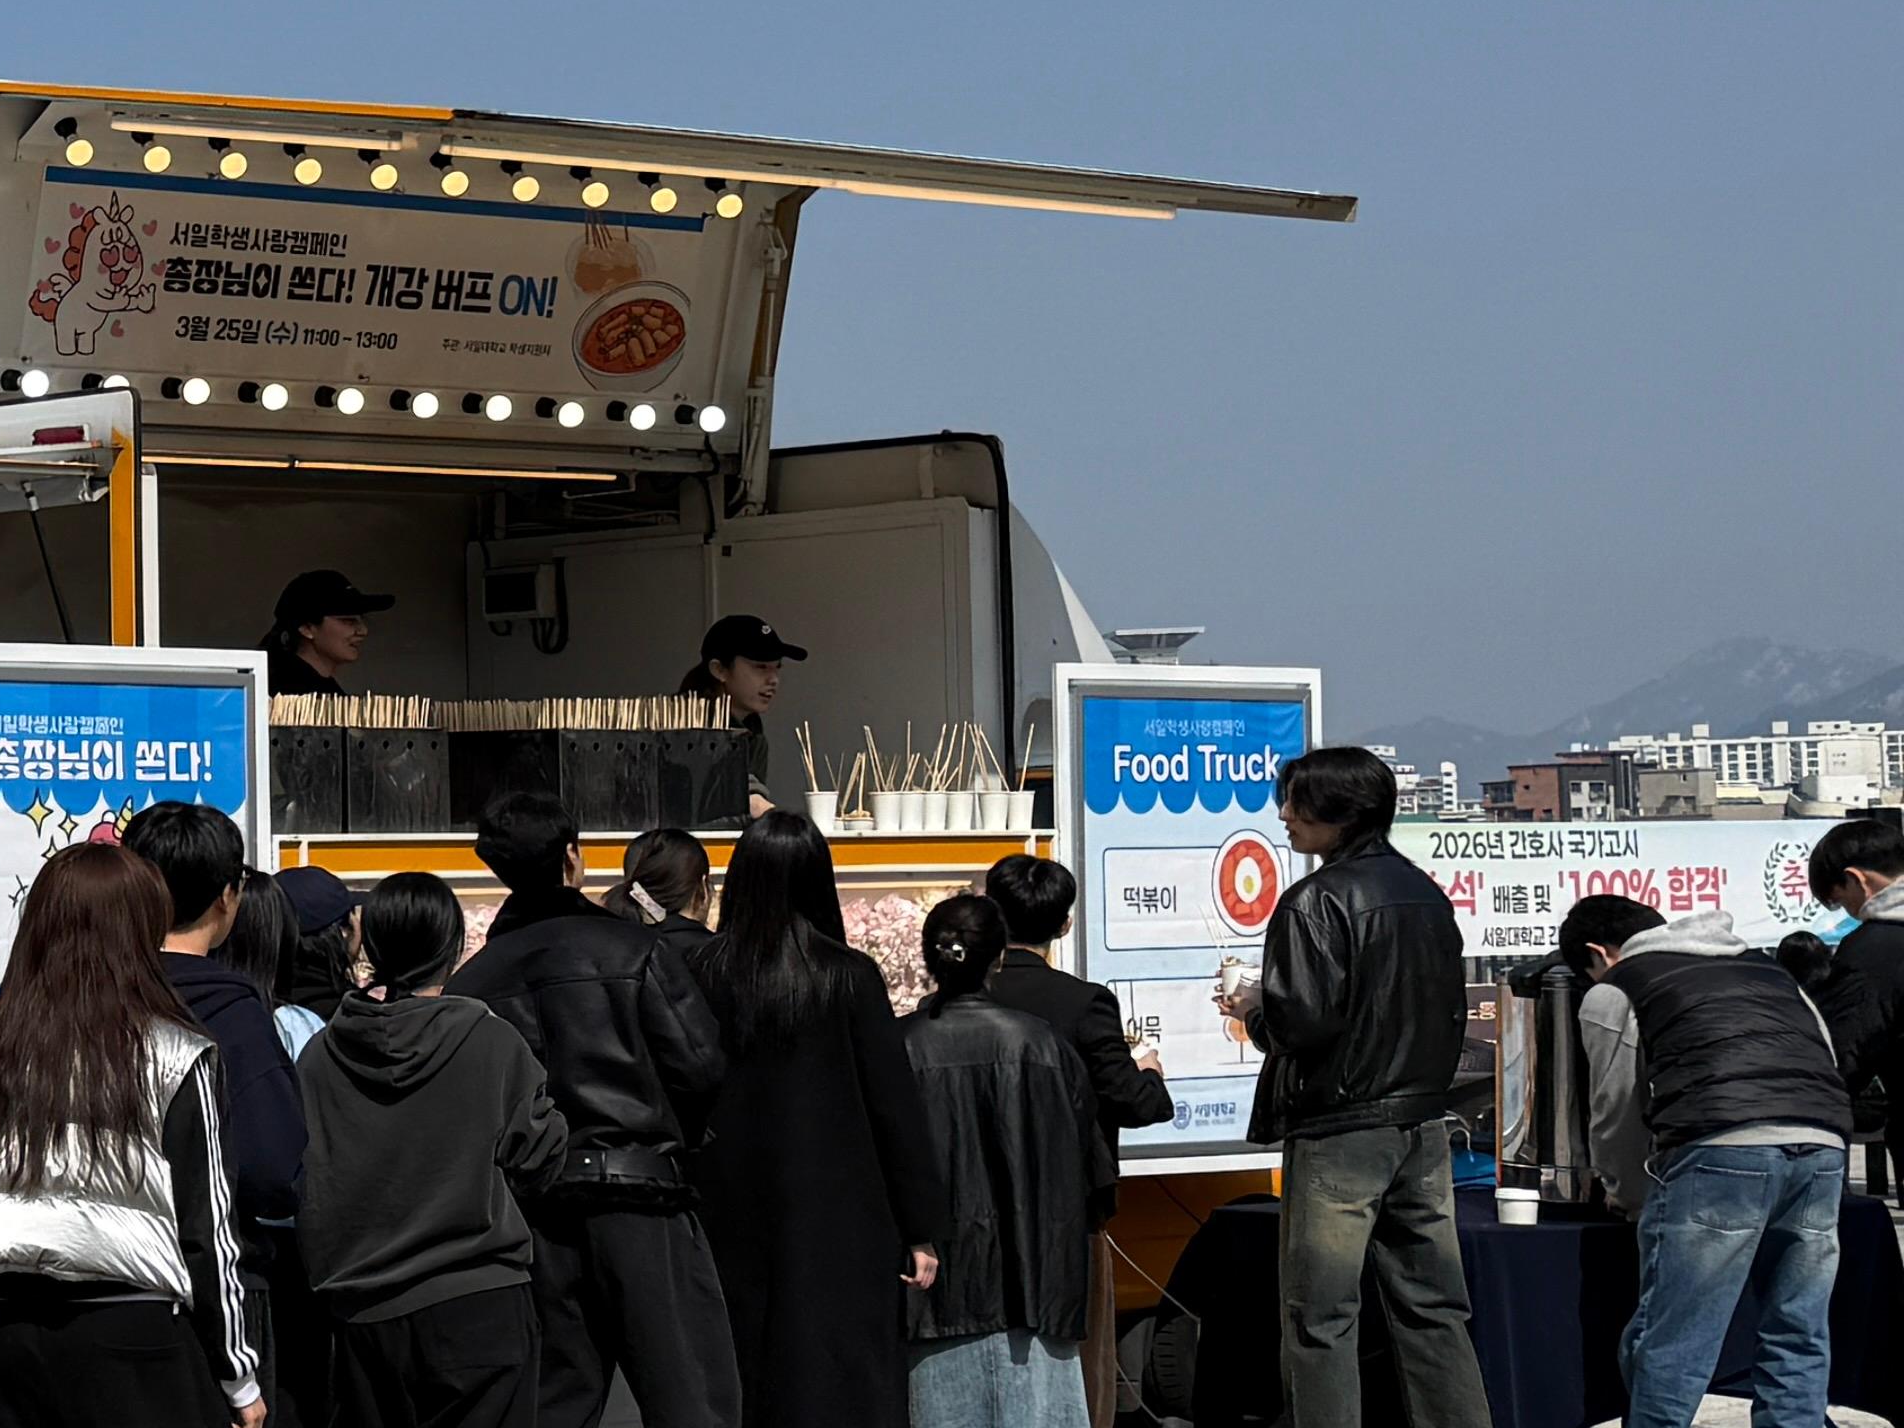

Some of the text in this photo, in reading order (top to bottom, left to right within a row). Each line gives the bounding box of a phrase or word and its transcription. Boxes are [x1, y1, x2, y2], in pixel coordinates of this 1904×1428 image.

[169, 221, 348, 257] 서일학생사랑캠페인
[163, 256, 558, 318] 총장님이 쏜다! 개강 버프 ON!
[175, 315, 210, 342] 3월
[213, 318, 260, 344] 25일
[265, 320, 298, 345] (수)
[303, 328, 339, 347] 11:00
[356, 331, 398, 350] 13:00
[135, 740, 212, 782] 쏜다!
[1113, 744, 1281, 783] Food Truck
[1429, 829, 1639, 860] 2026년 간호사 국가고시
[1124, 885, 1177, 914] 떡볶이
[1493, 885, 1529, 914] 배출
[1534, 884, 1551, 913] 및
[1667, 866, 1728, 910] 합격'
[1779, 859, 1808, 908] 축
[1482, 926, 1545, 947] 서일대학교
